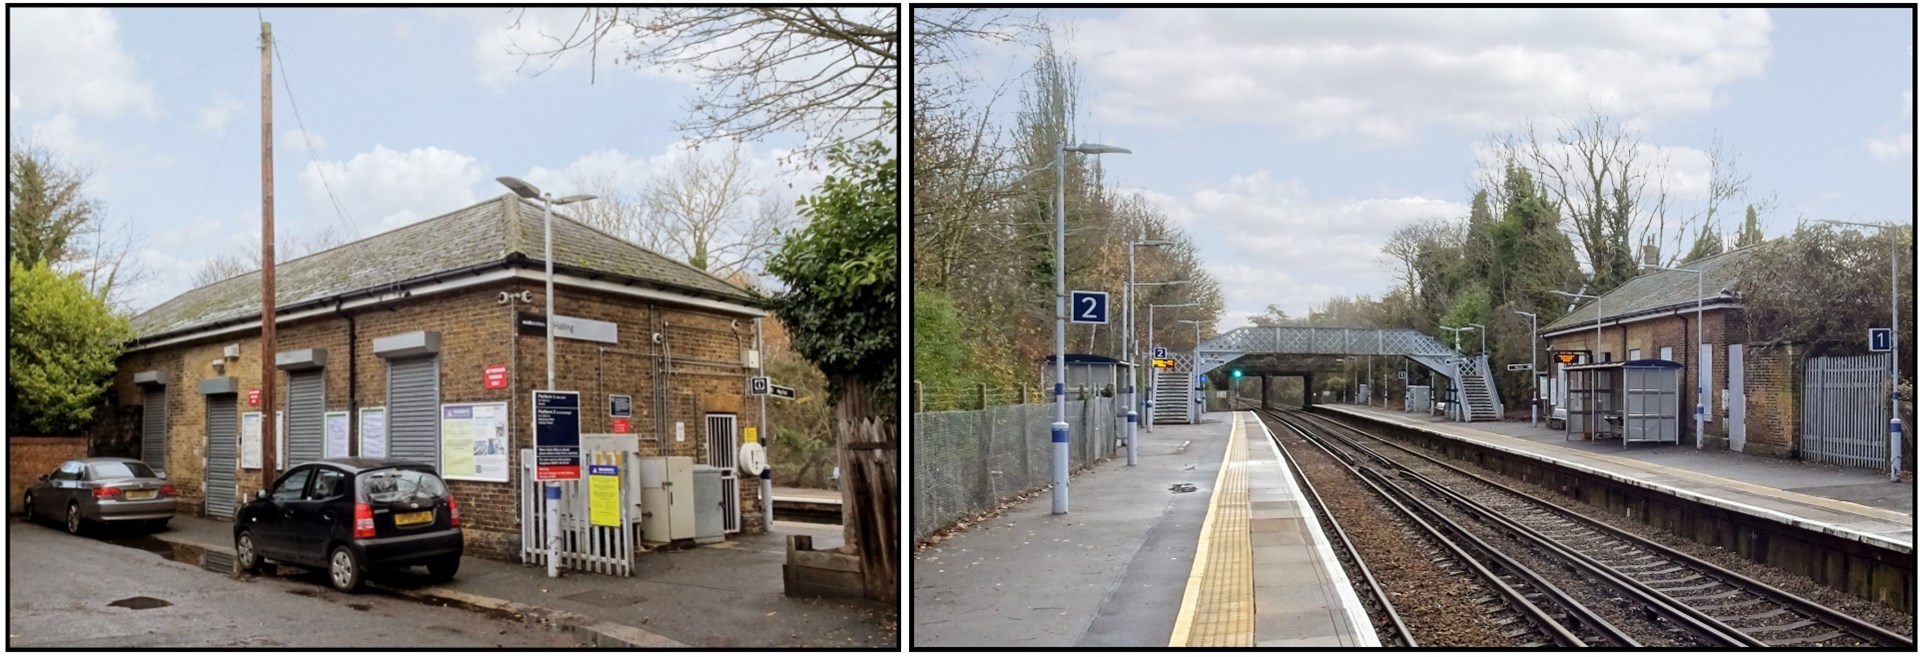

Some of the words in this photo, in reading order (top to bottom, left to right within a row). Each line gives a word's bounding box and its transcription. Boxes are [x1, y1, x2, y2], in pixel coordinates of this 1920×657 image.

[1081, 296, 1097, 318] 2
[1877, 332, 1884, 348] 1
[1157, 349, 1164, 357] 2
